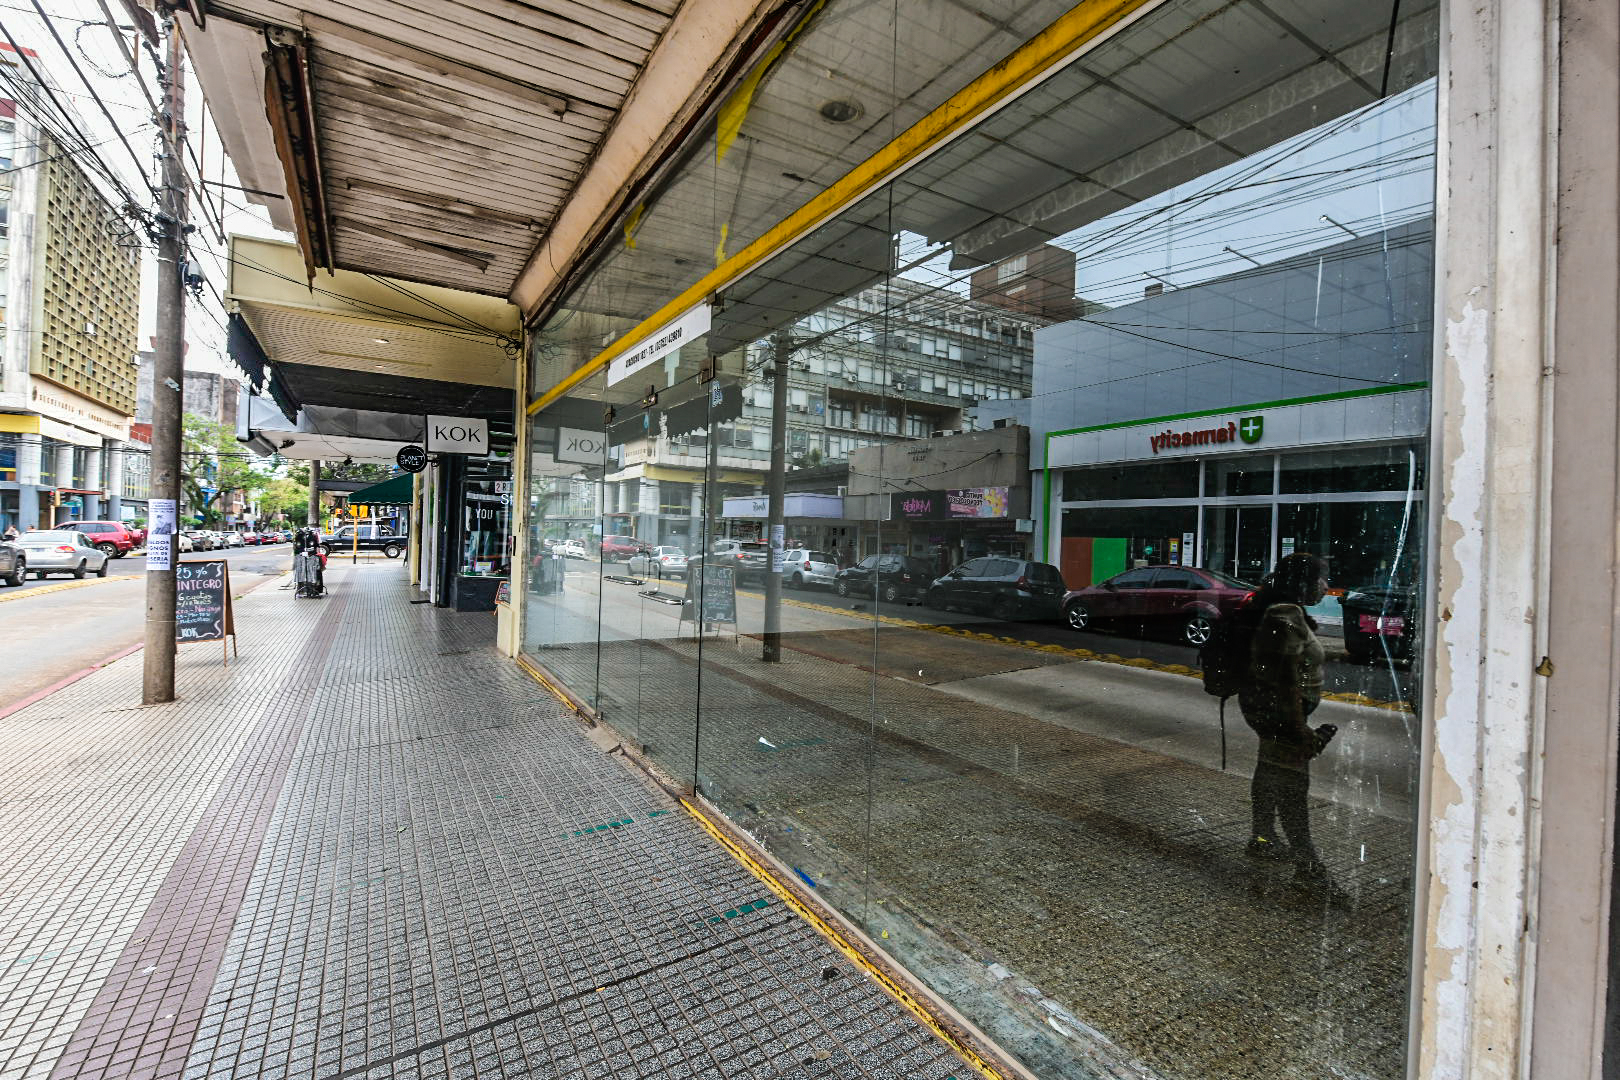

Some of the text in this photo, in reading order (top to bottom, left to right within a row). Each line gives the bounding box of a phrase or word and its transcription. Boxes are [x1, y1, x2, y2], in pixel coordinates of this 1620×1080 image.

[435, 425, 481, 443] KOK
[475, 508, 493, 520] YOU
[195, 566, 208, 578] %
[181, 627, 199, 638] KOK
